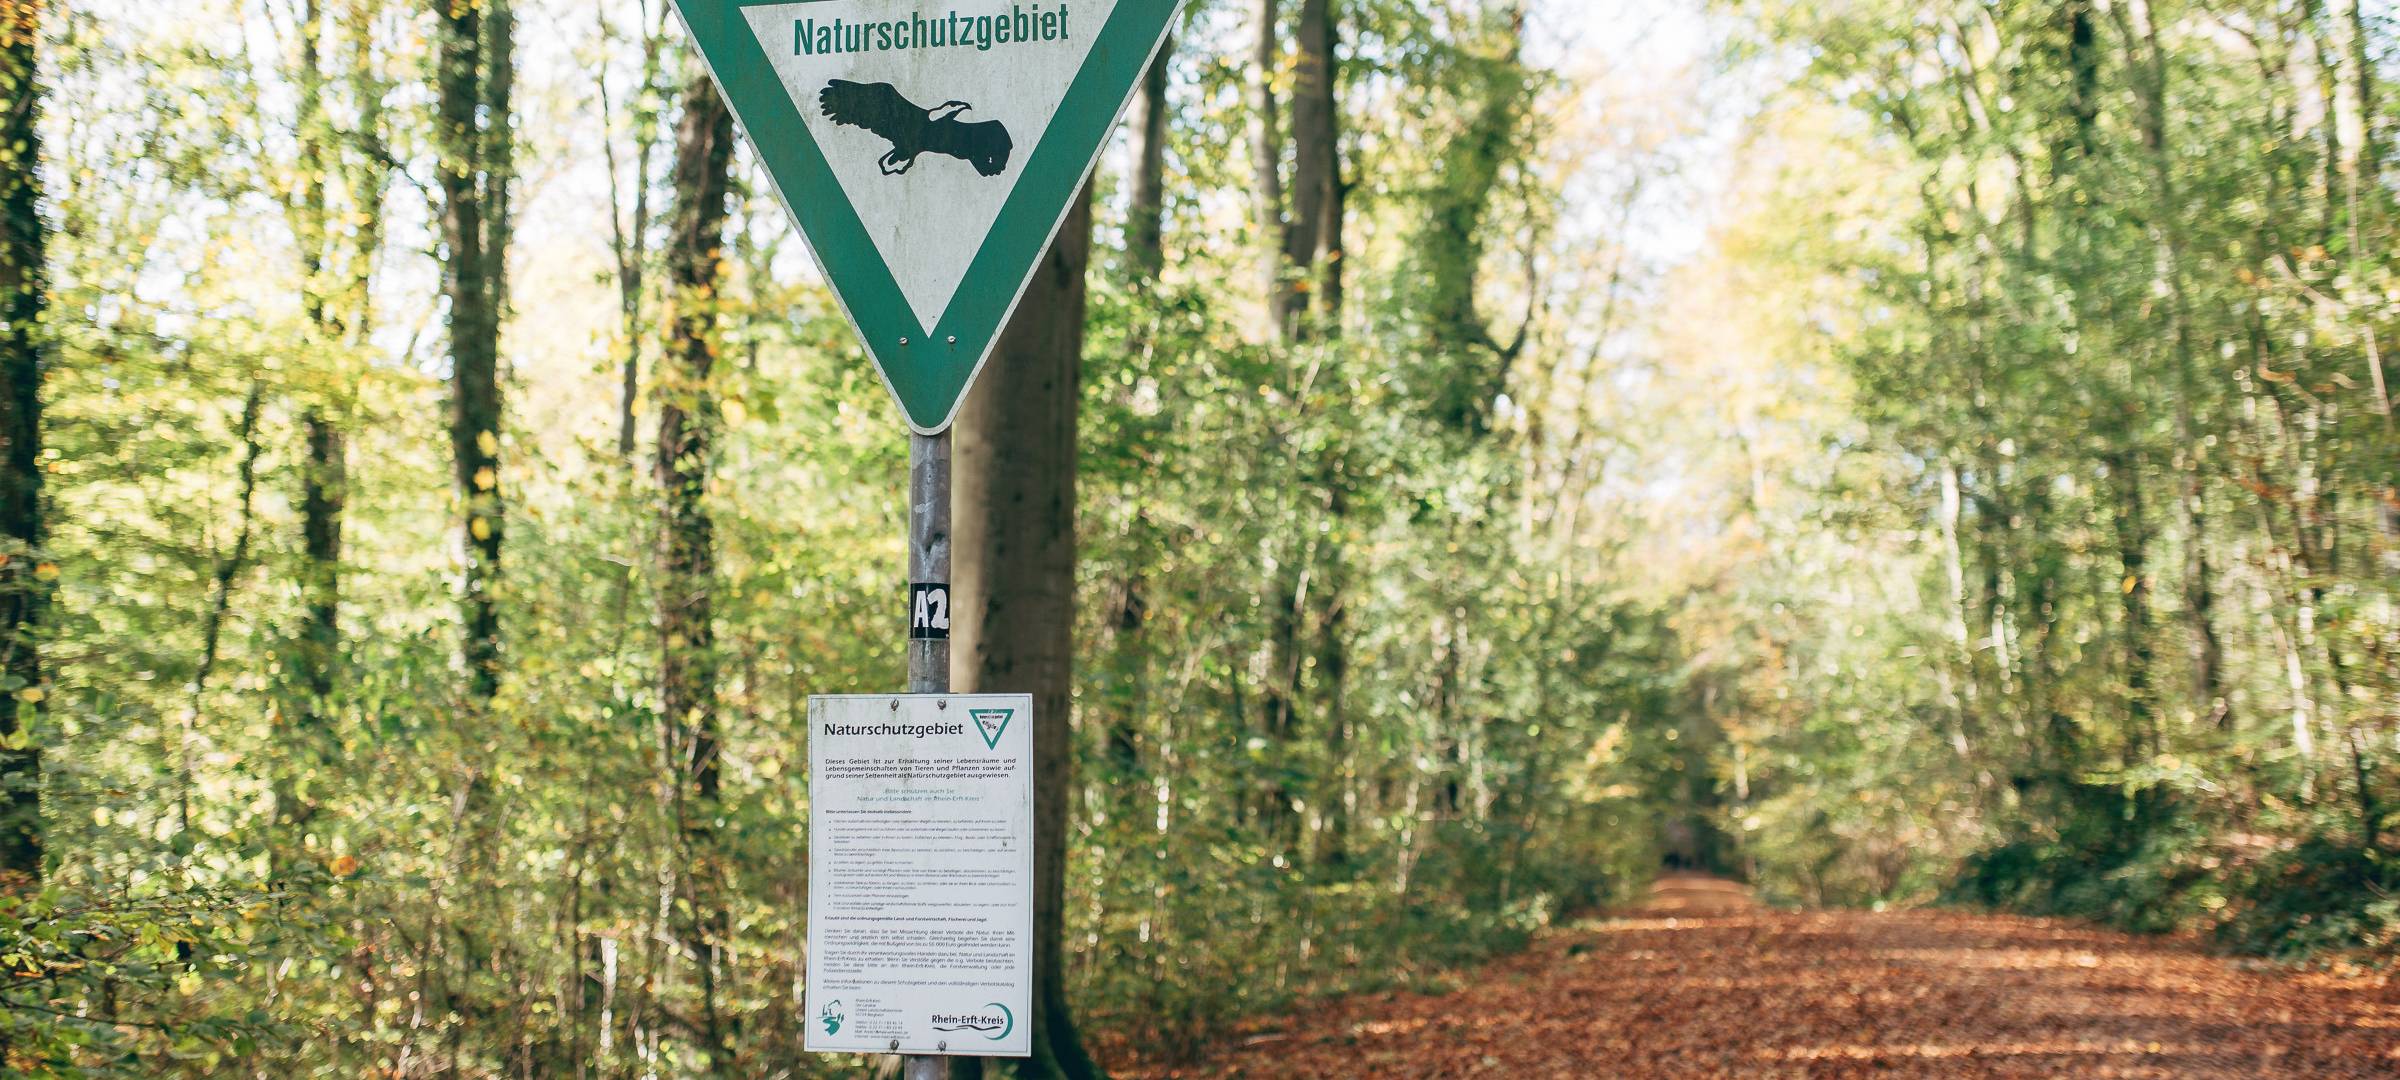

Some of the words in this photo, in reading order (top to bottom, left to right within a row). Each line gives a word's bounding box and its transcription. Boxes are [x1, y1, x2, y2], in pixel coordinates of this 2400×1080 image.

[794, 4, 1069, 56] Naturschutzgebiet
[913, 588, 950, 630] A2
[824, 722, 964, 738] Naturschutzgebiet
[825, 772, 845, 780] grund
[845, 772, 864, 780] seiner
[907, 772, 966, 780] Naturschutzgebiet
[931, 1014, 1004, 1025] Rhein-Erft-Kreis
